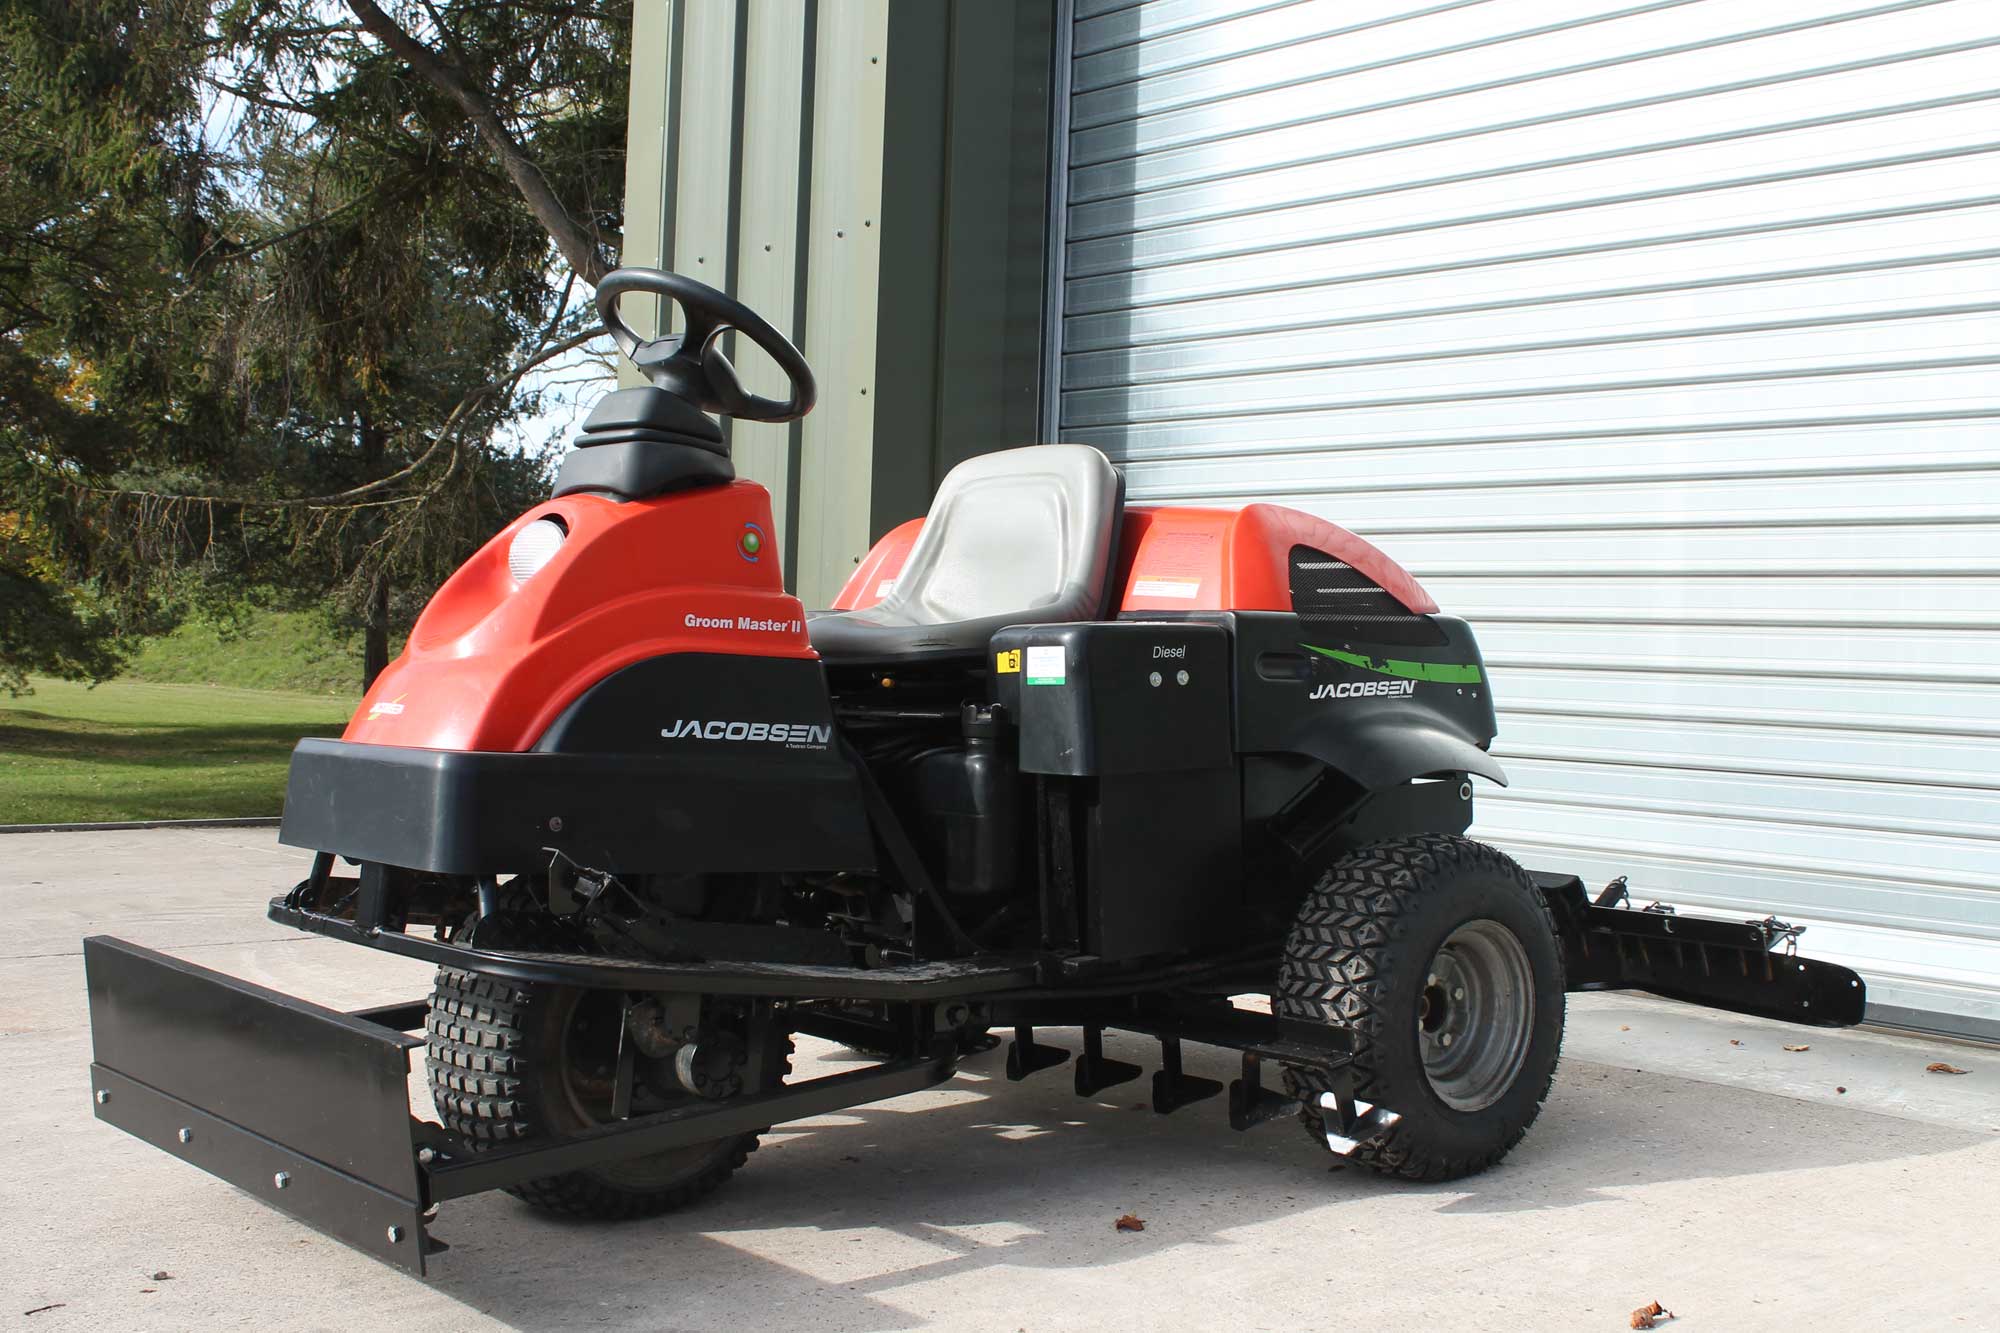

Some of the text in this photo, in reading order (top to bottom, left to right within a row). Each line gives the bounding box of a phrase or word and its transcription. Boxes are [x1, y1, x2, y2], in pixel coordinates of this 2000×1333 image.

[684, 613, 801, 633] Groom Master II
[1152, 645, 1186, 659] Diesel
[1309, 680, 1415, 700] JACOBSEN
[661, 719, 832, 743] JACOBSEN
